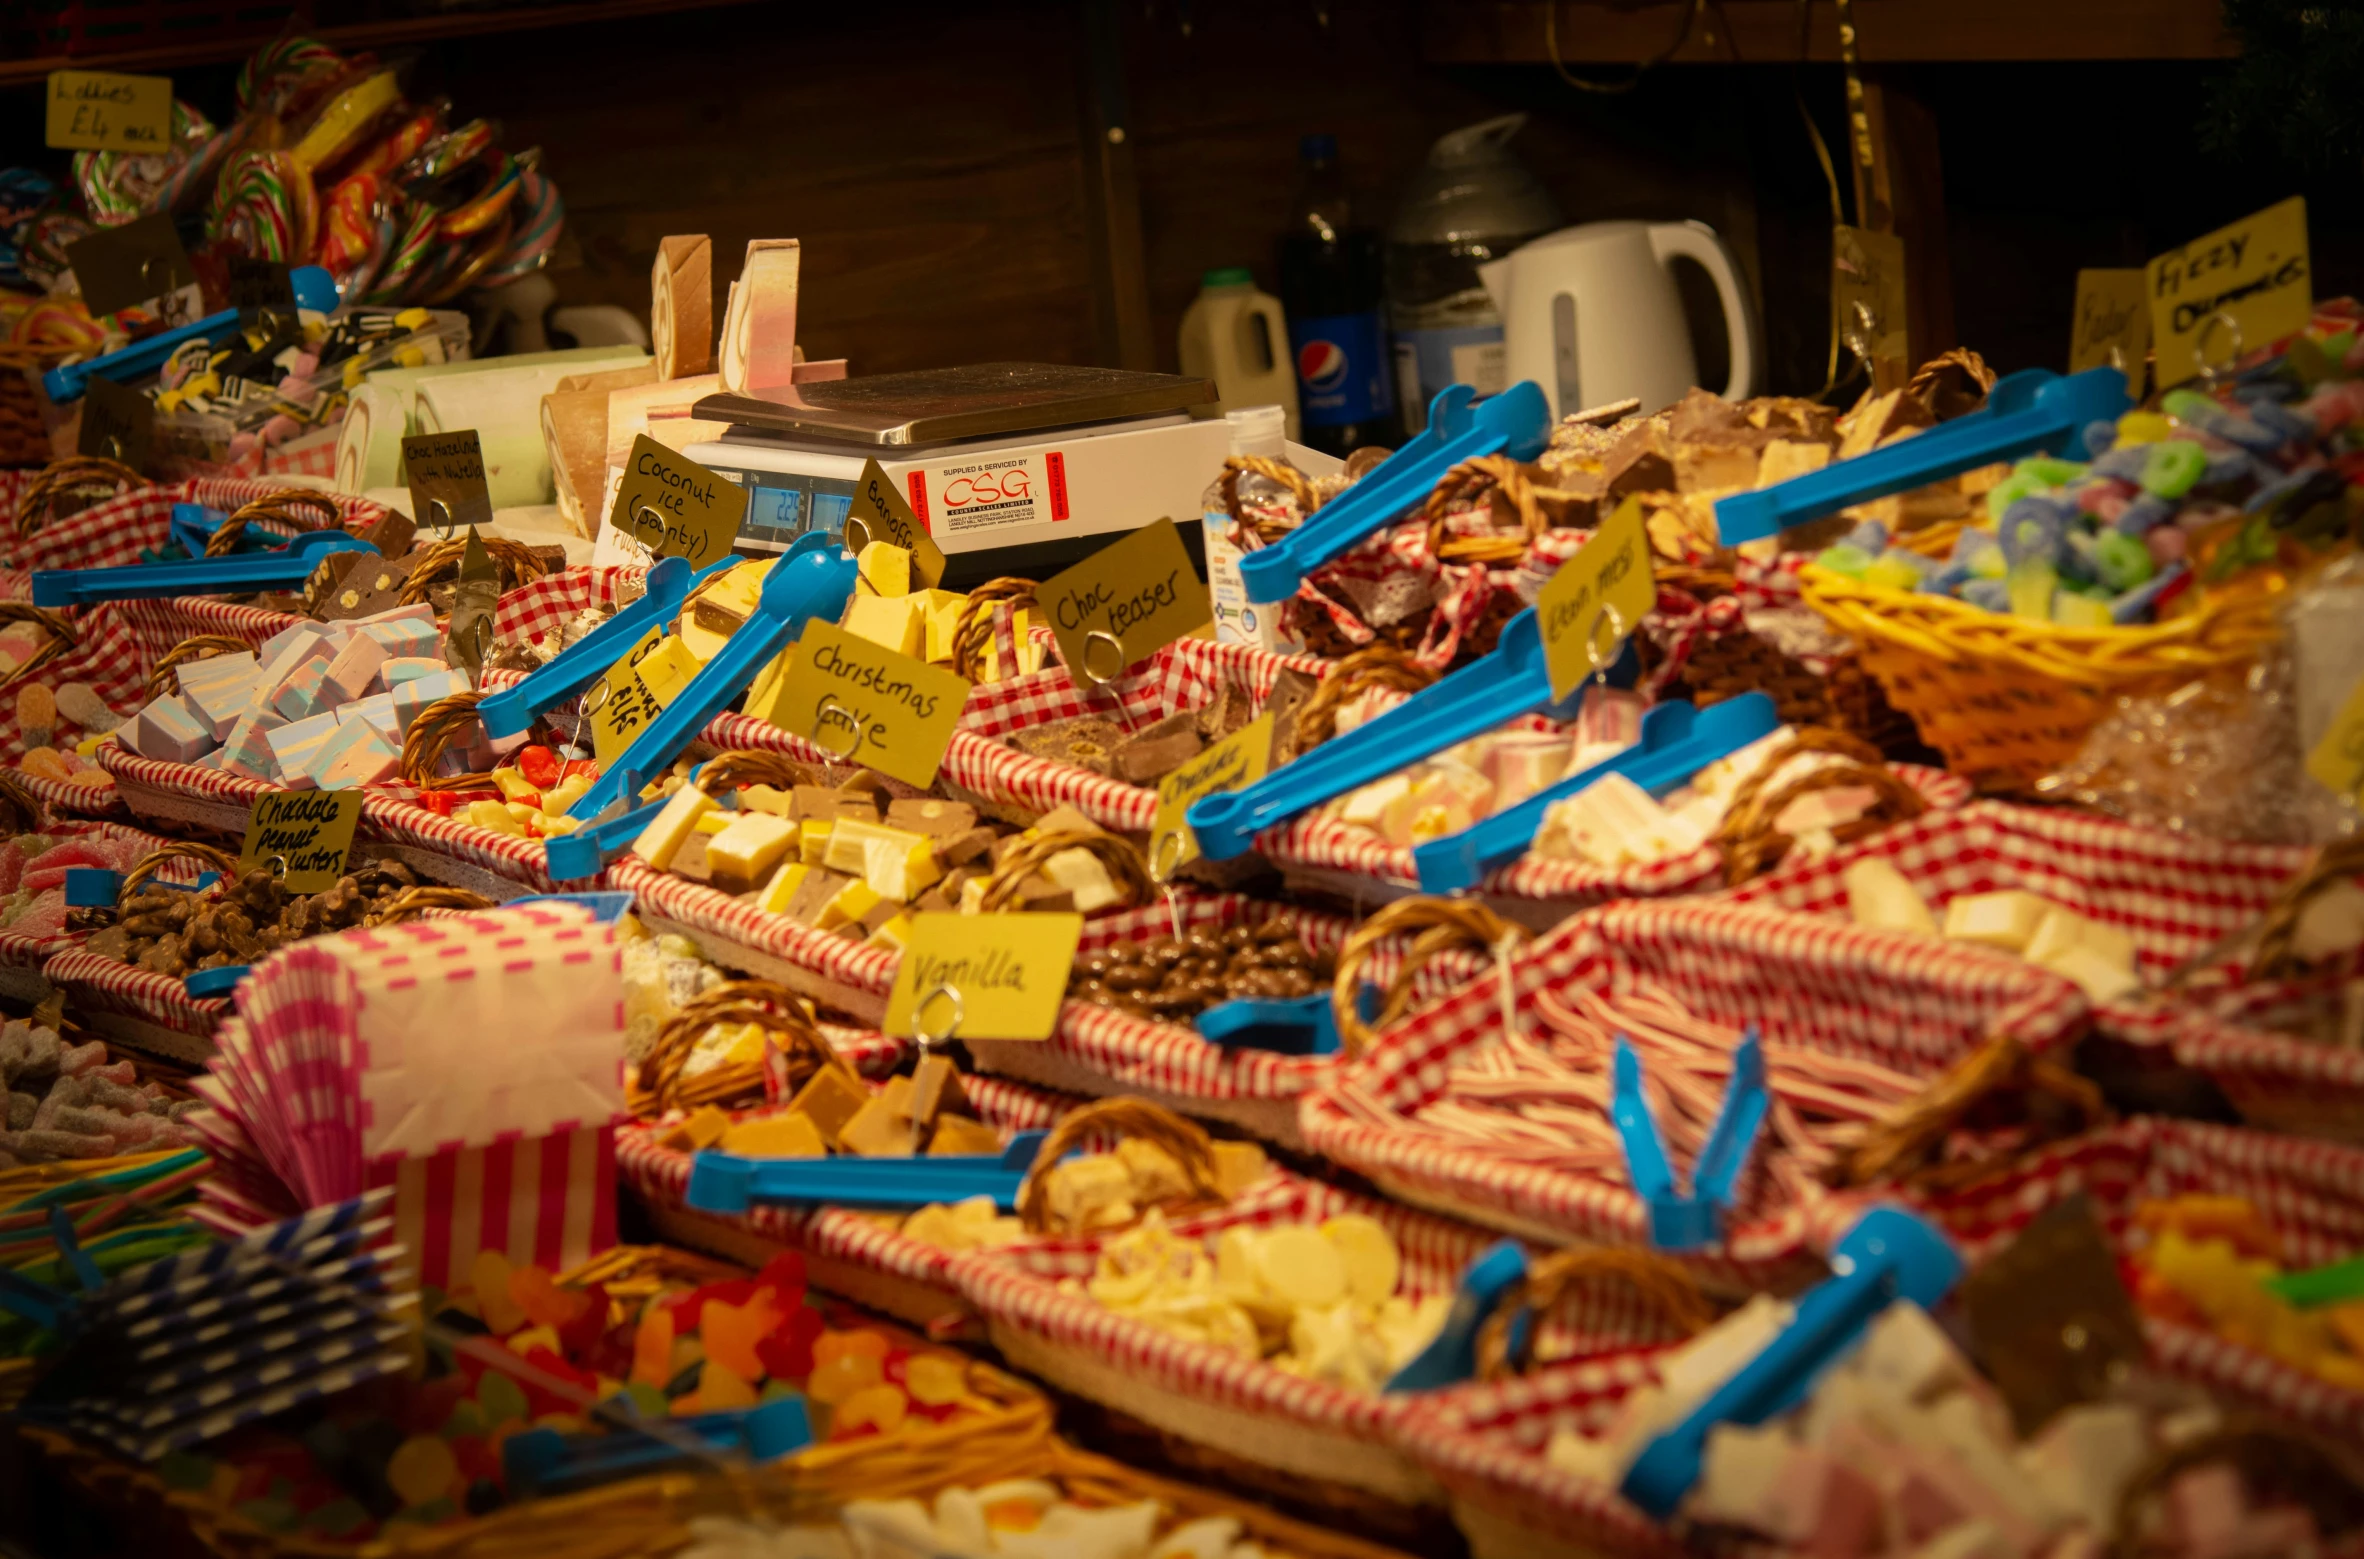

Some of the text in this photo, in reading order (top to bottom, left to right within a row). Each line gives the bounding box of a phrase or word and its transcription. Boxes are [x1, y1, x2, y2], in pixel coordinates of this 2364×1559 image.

[407, 434, 481, 460] Choc Hazelnut
[443, 458, 487, 481] Nutella
[943, 466, 976, 476] SUPPLIED
[984, 460, 1017, 470] SERVICED
[1018, 458, 1028, 466] BY
[638, 453, 716, 509] Coconut
[943, 469, 1031, 507] CSG
[867, 480, 921, 571] Banoffee
[950, 500, 1029, 515] COUNTY SCALES LIMITED
[1057, 582, 1116, 631] Choc
[1108, 569, 1179, 637] teaser
[813, 644, 940, 719] Christmas
[816, 693, 888, 750] Cake
[253, 824, 321, 857] peanut
[912, 945, 1027, 995] Vanilla
